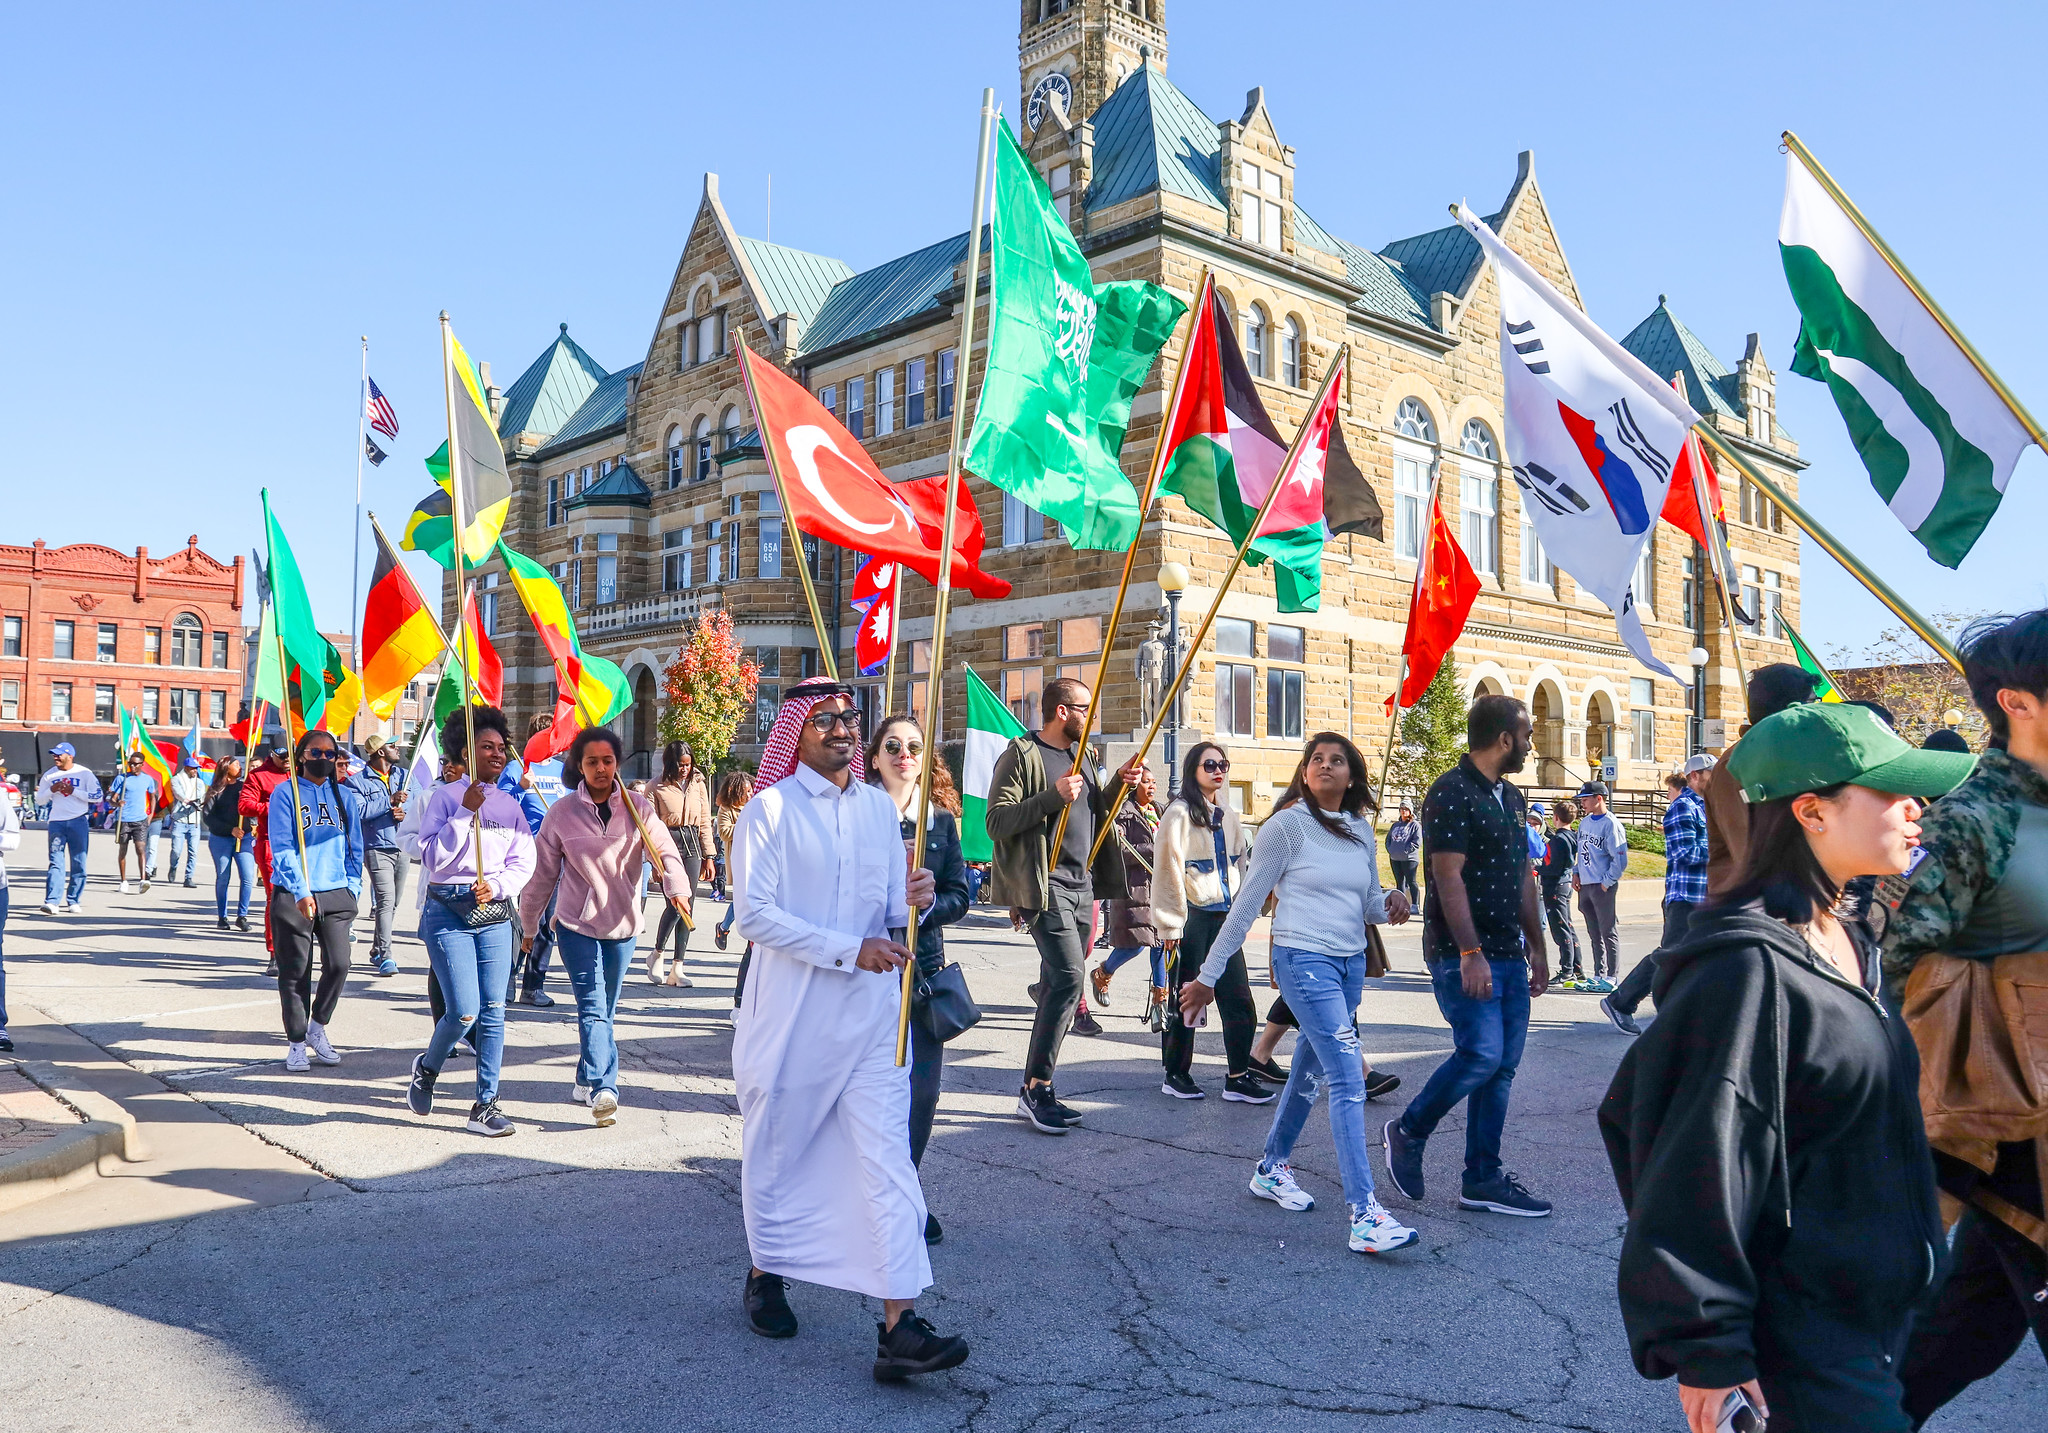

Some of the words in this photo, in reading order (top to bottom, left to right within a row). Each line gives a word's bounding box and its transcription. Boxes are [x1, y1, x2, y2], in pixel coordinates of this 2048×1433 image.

[946, 368, 953, 379] 83
[917, 380, 924, 390] 82
[763, 542, 778, 553] 65A
[803, 542, 817, 553] 66A
[763, 552, 773, 562] 65
[601, 578, 614, 587] 60A
[601, 587, 610, 596] 60
[760, 711, 775, 721] 47A
[760, 722, 769, 732] 47
